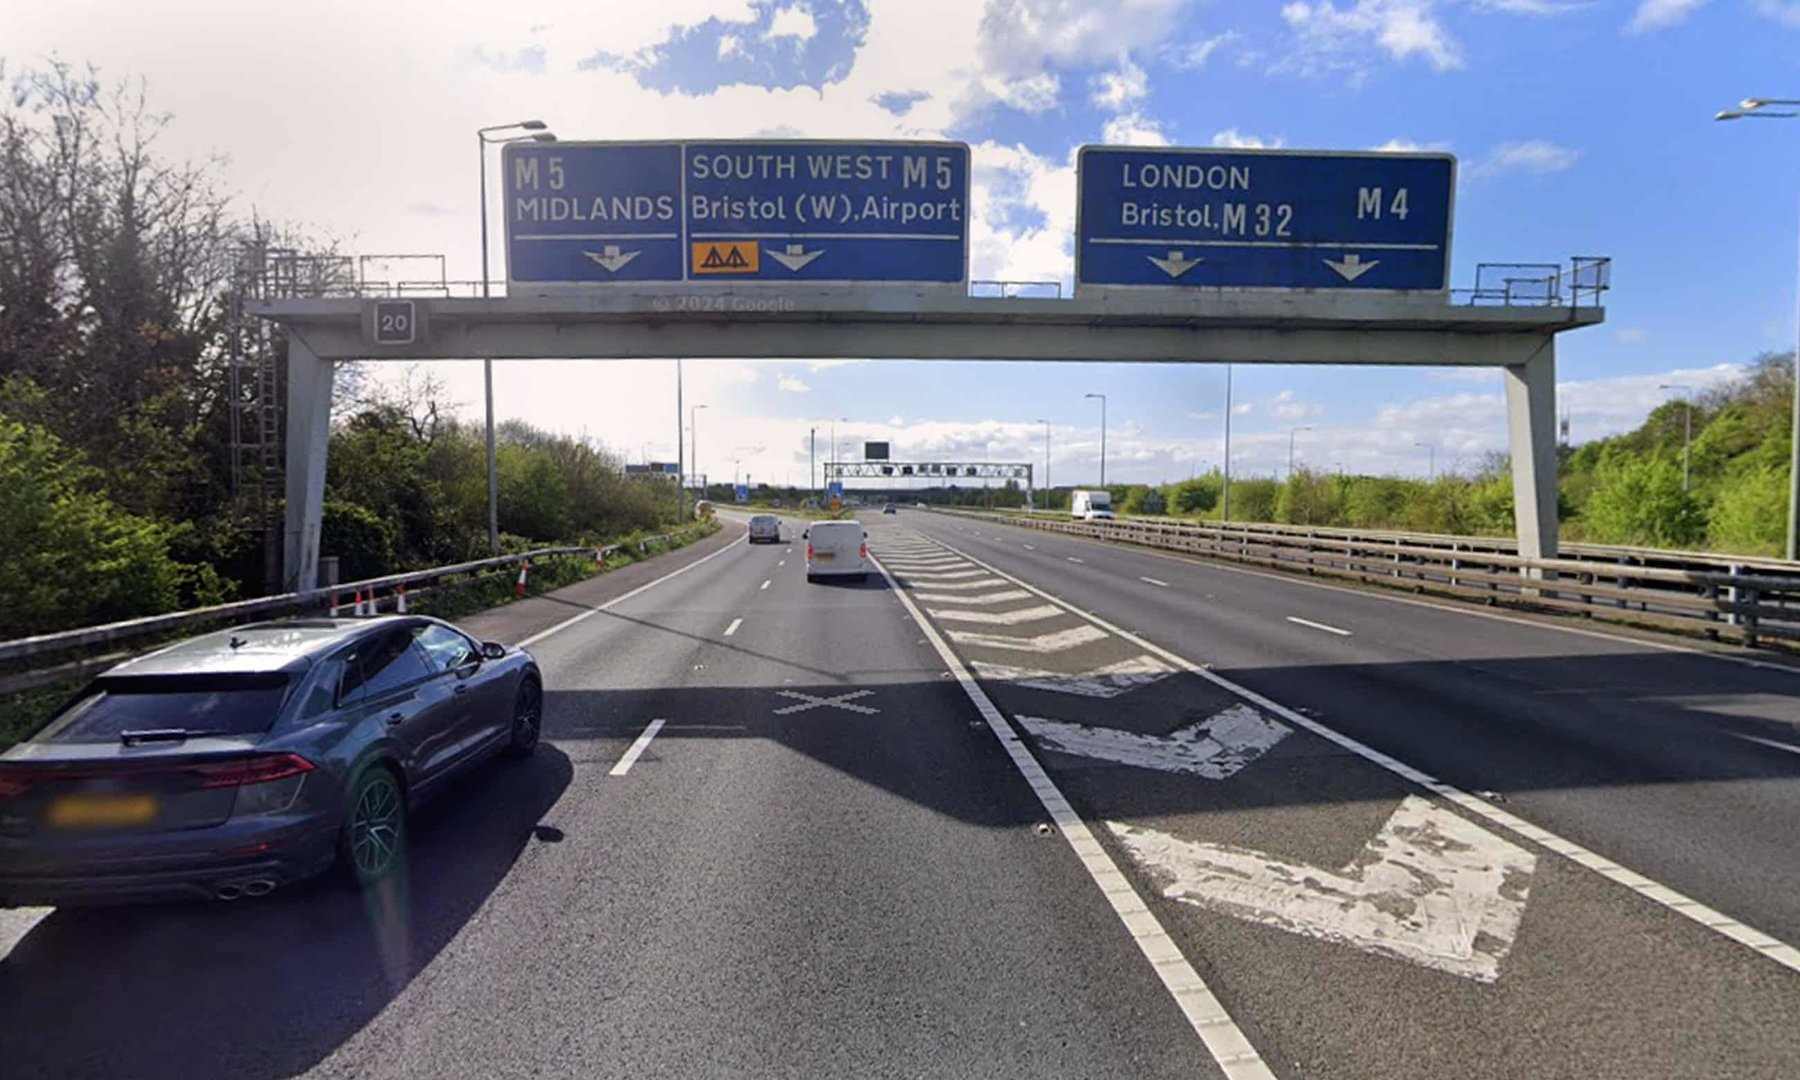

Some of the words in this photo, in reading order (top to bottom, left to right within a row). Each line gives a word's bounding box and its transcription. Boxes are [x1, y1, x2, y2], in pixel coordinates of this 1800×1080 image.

[692, 154, 795, 179] SOUTH
[807, 155, 893, 179] WEST
[1122, 164, 1249, 190] LONDON
[516, 196, 674, 221] MIDLANDS
[692, 195, 787, 219] Bristol
[381, 314, 408, 332] 20
